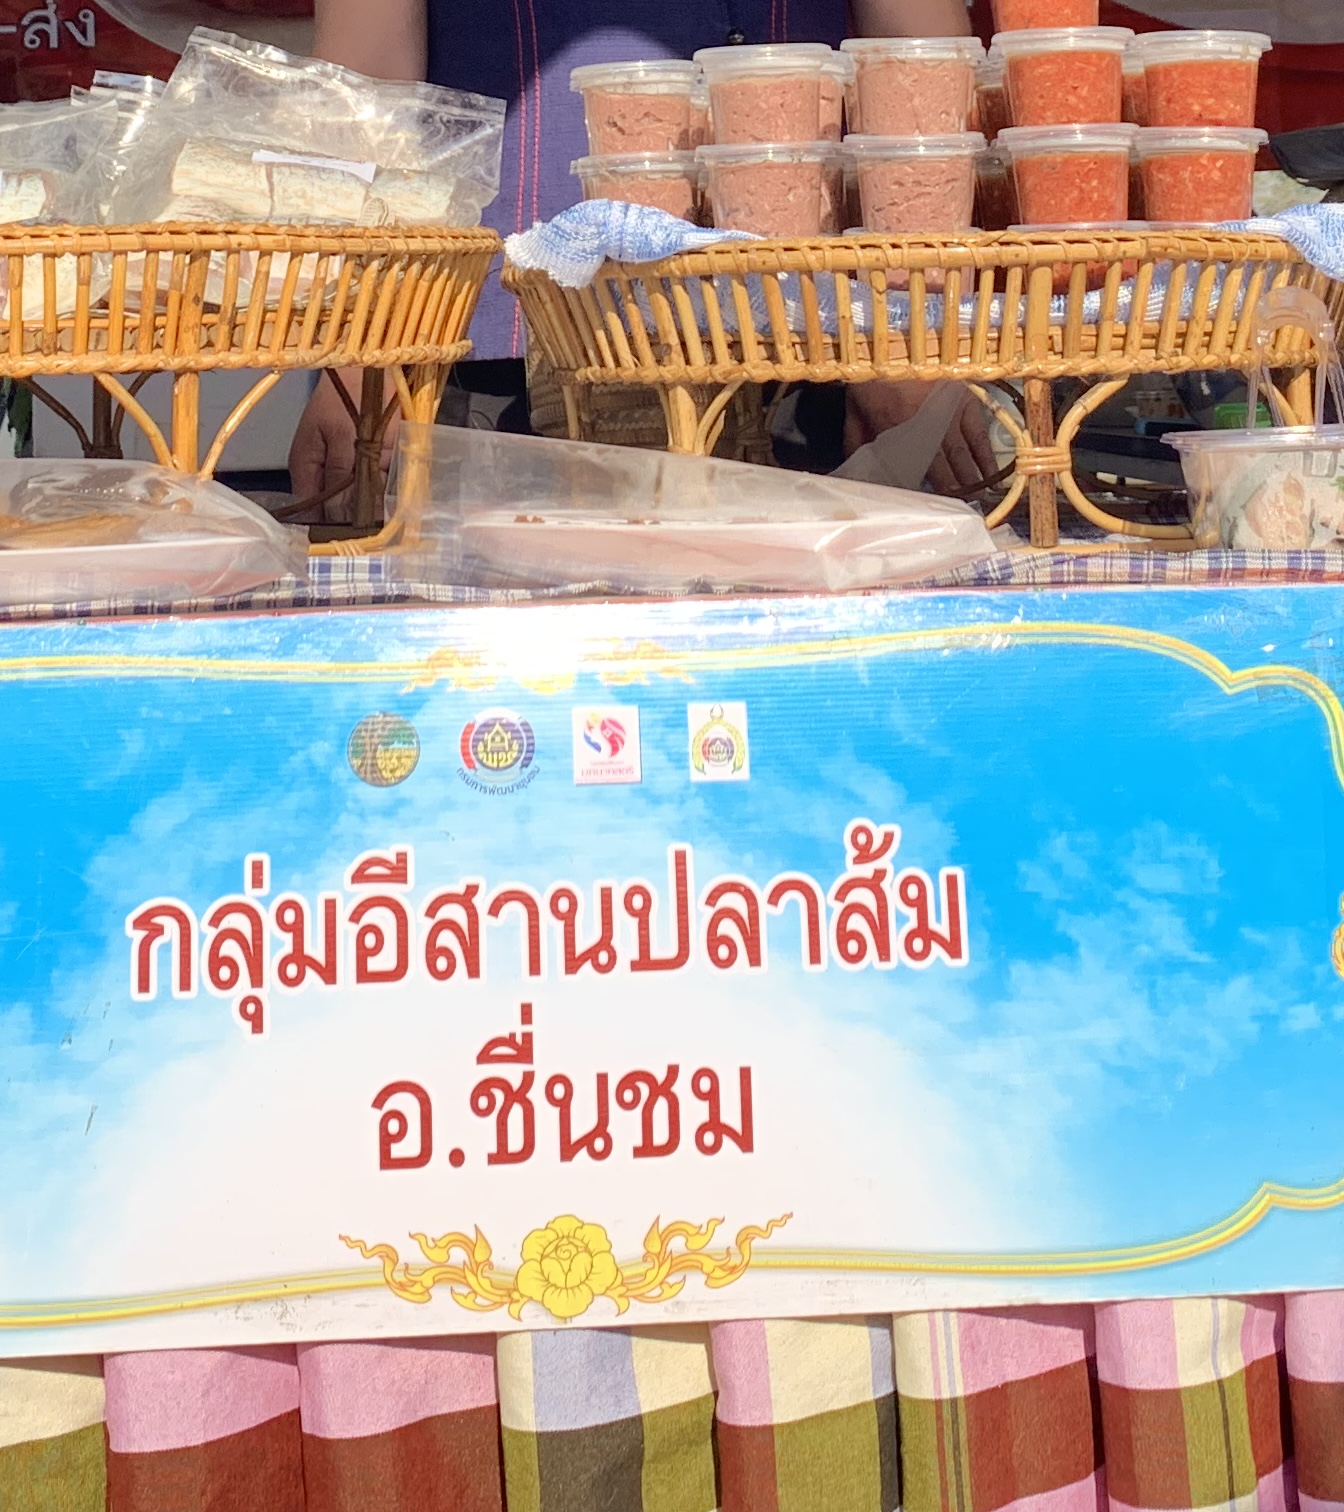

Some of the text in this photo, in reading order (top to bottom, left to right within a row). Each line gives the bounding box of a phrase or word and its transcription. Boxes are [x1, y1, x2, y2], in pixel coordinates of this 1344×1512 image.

[130, 825, 965, 1035] กลุ่มอีสานปลาส้ม
[371, 1002, 756, 1171] อ.ชื่นชม
